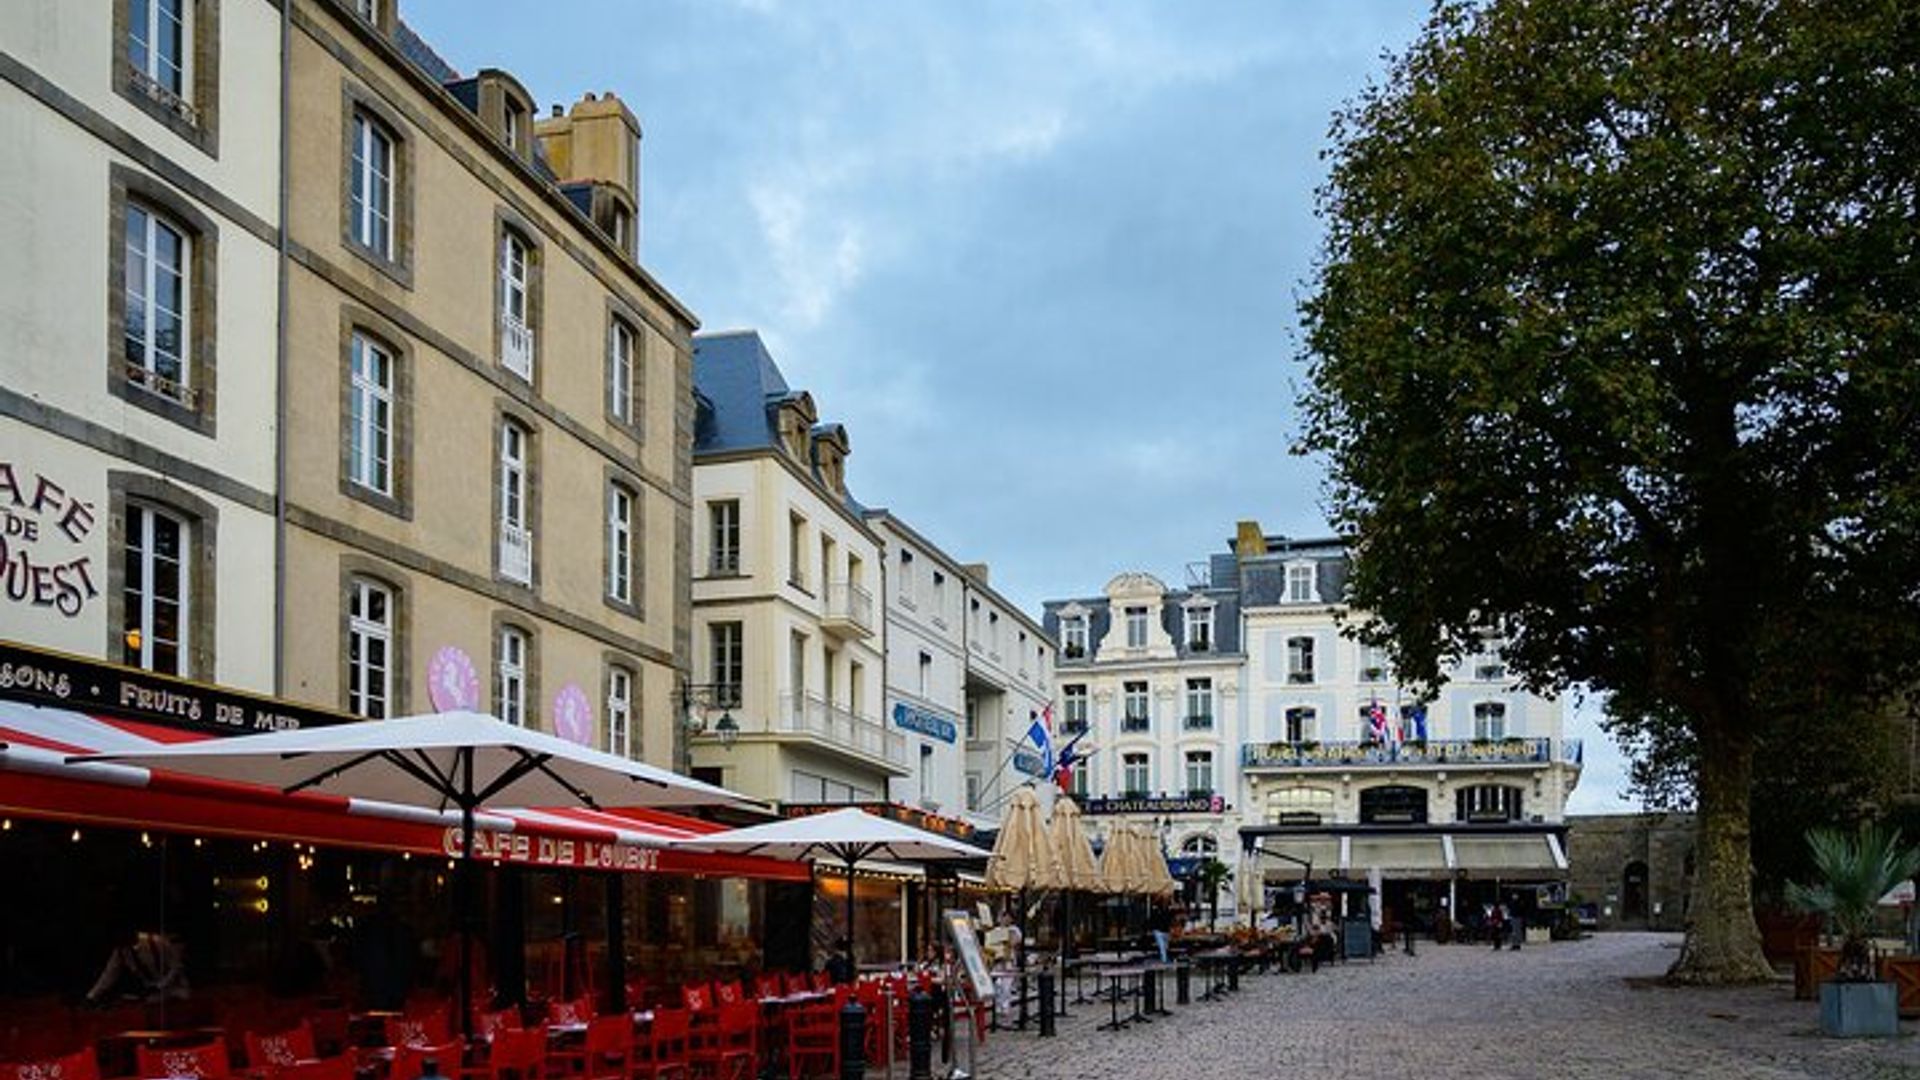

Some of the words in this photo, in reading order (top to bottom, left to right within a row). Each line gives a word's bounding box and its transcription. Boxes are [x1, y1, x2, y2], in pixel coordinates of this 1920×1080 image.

[6, 514, 38, 541] DE
[120, 681, 201, 720] FRUITS
[216, 703, 244, 725] DE
[538, 836, 575, 865] DE
